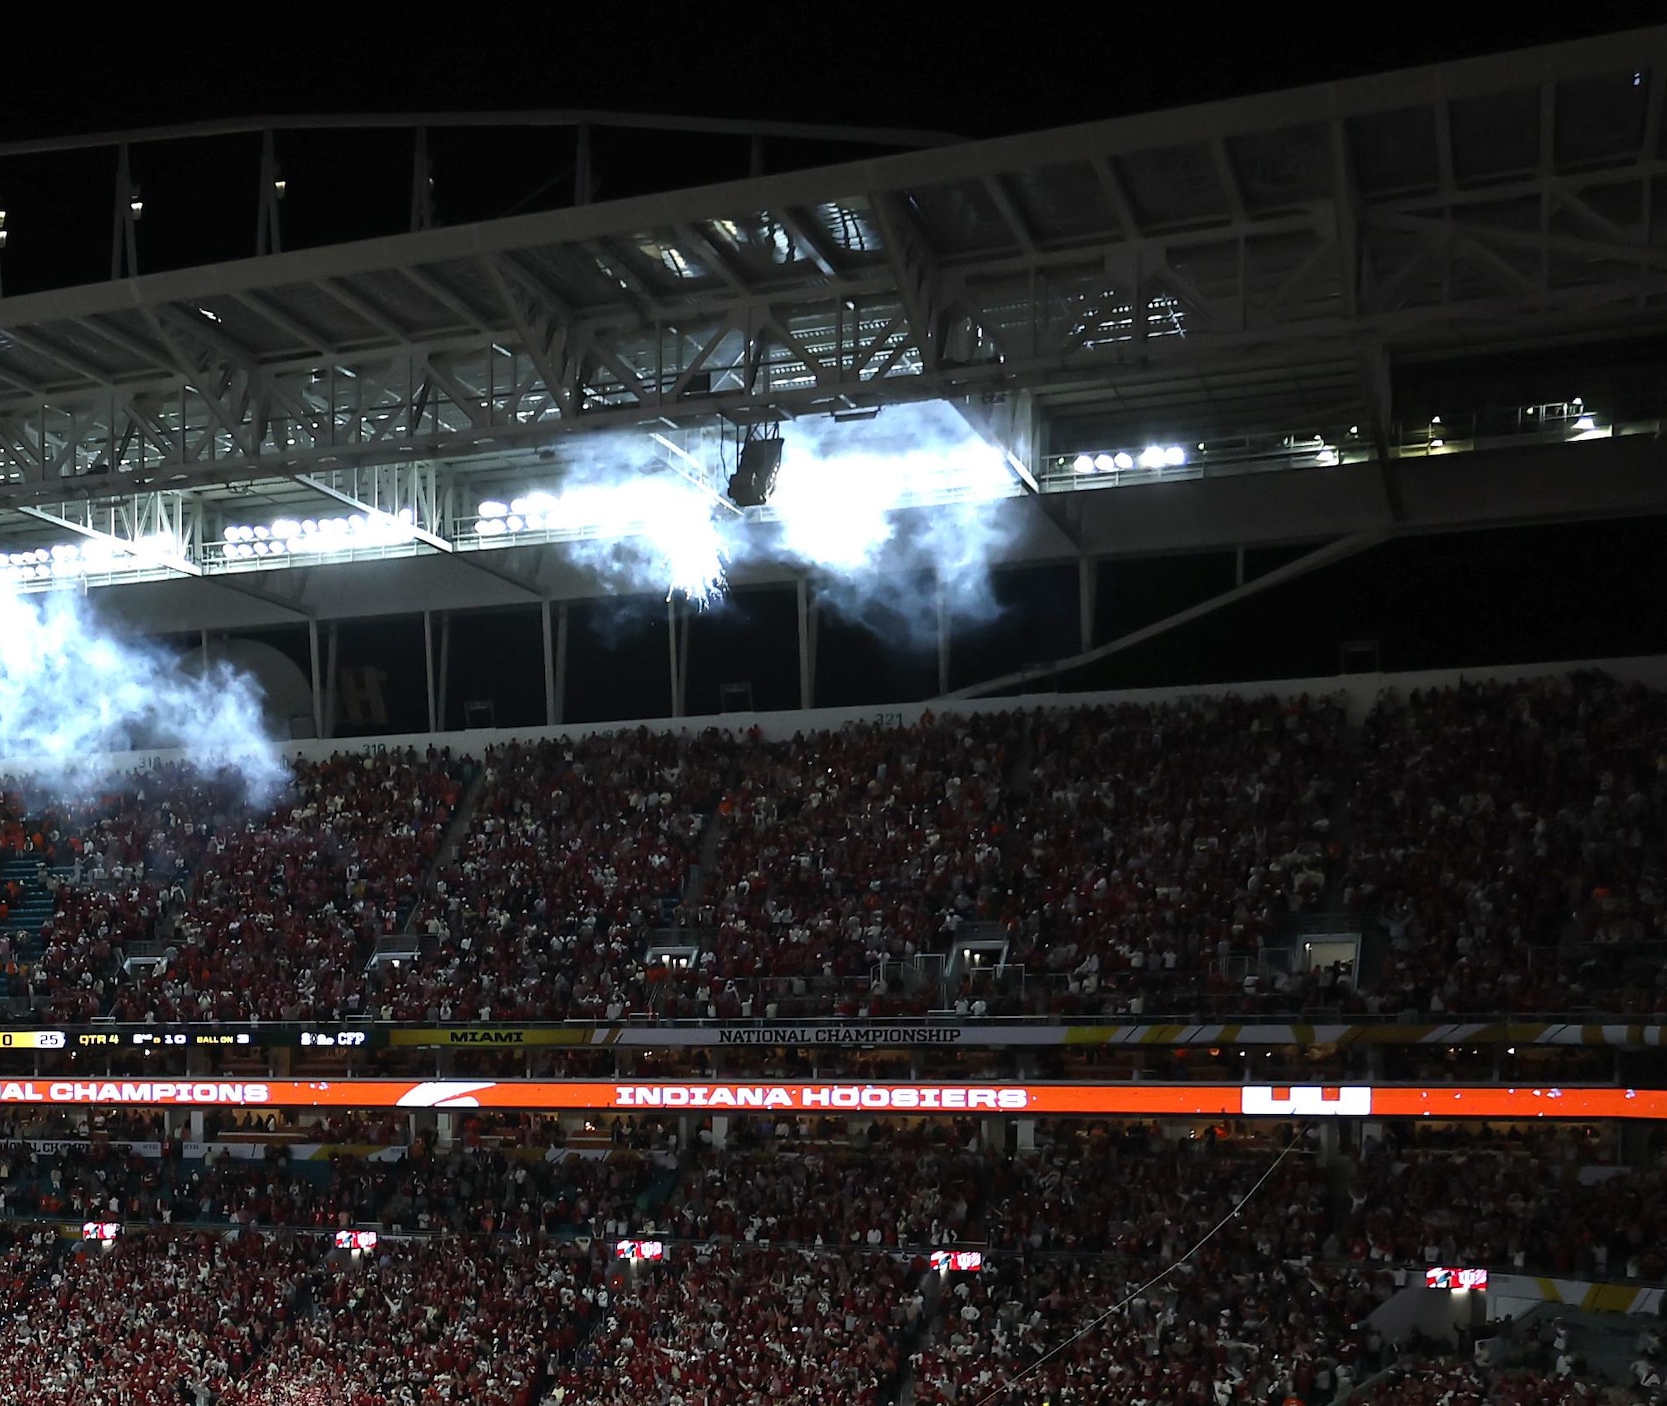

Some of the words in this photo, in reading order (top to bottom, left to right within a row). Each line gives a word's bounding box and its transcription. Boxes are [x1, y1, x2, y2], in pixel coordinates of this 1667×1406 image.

[40, 1034, 58, 1046] 25
[79, 1034, 107, 1047] QTR
[109, 1034, 119, 1045] 4
[450, 1031, 524, 1043] MIAMI
[719, 1028, 812, 1044] NATIONAL
[815, 1028, 961, 1044] CHAMPIONSHIP
[49, 1083, 268, 1103] CHAMPIONS
[616, 1085, 793, 1107] INDIANA
[802, 1086, 1028, 1108] HOOSIERS
